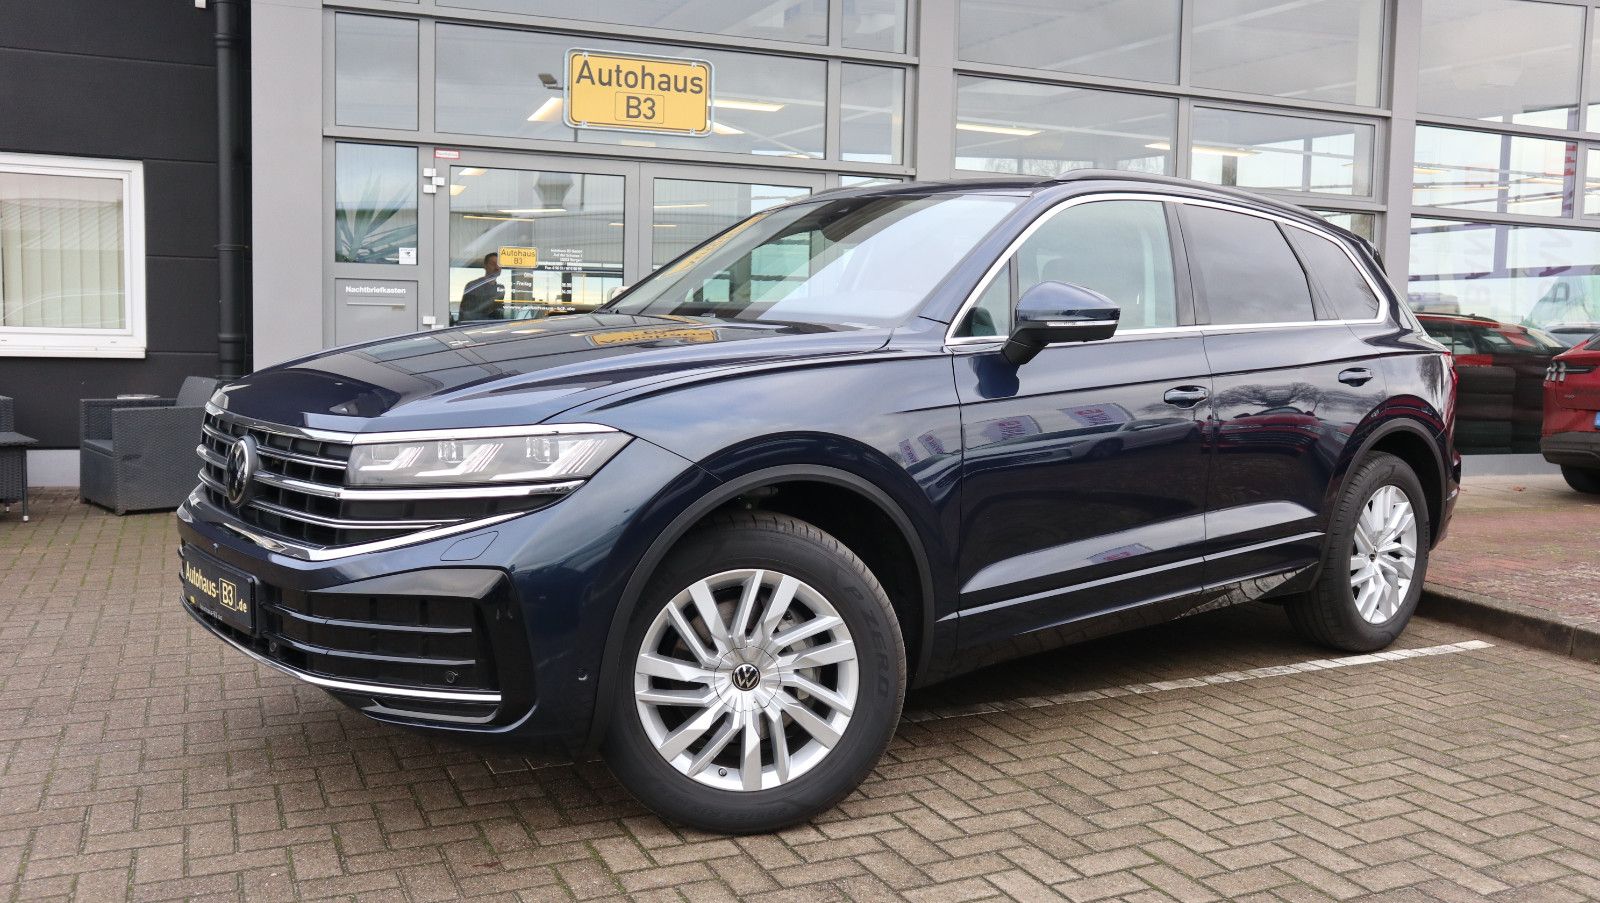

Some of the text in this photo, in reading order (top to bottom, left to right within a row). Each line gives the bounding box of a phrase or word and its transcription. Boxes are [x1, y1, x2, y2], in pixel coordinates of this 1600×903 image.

[576, 60, 703, 94] Autohaus
[625, 96, 656, 120] B3
[500, 248, 535, 257] Autohaus
[513, 257, 523, 265] B3
[345, 285, 406, 294] Nachtbriefkasten
